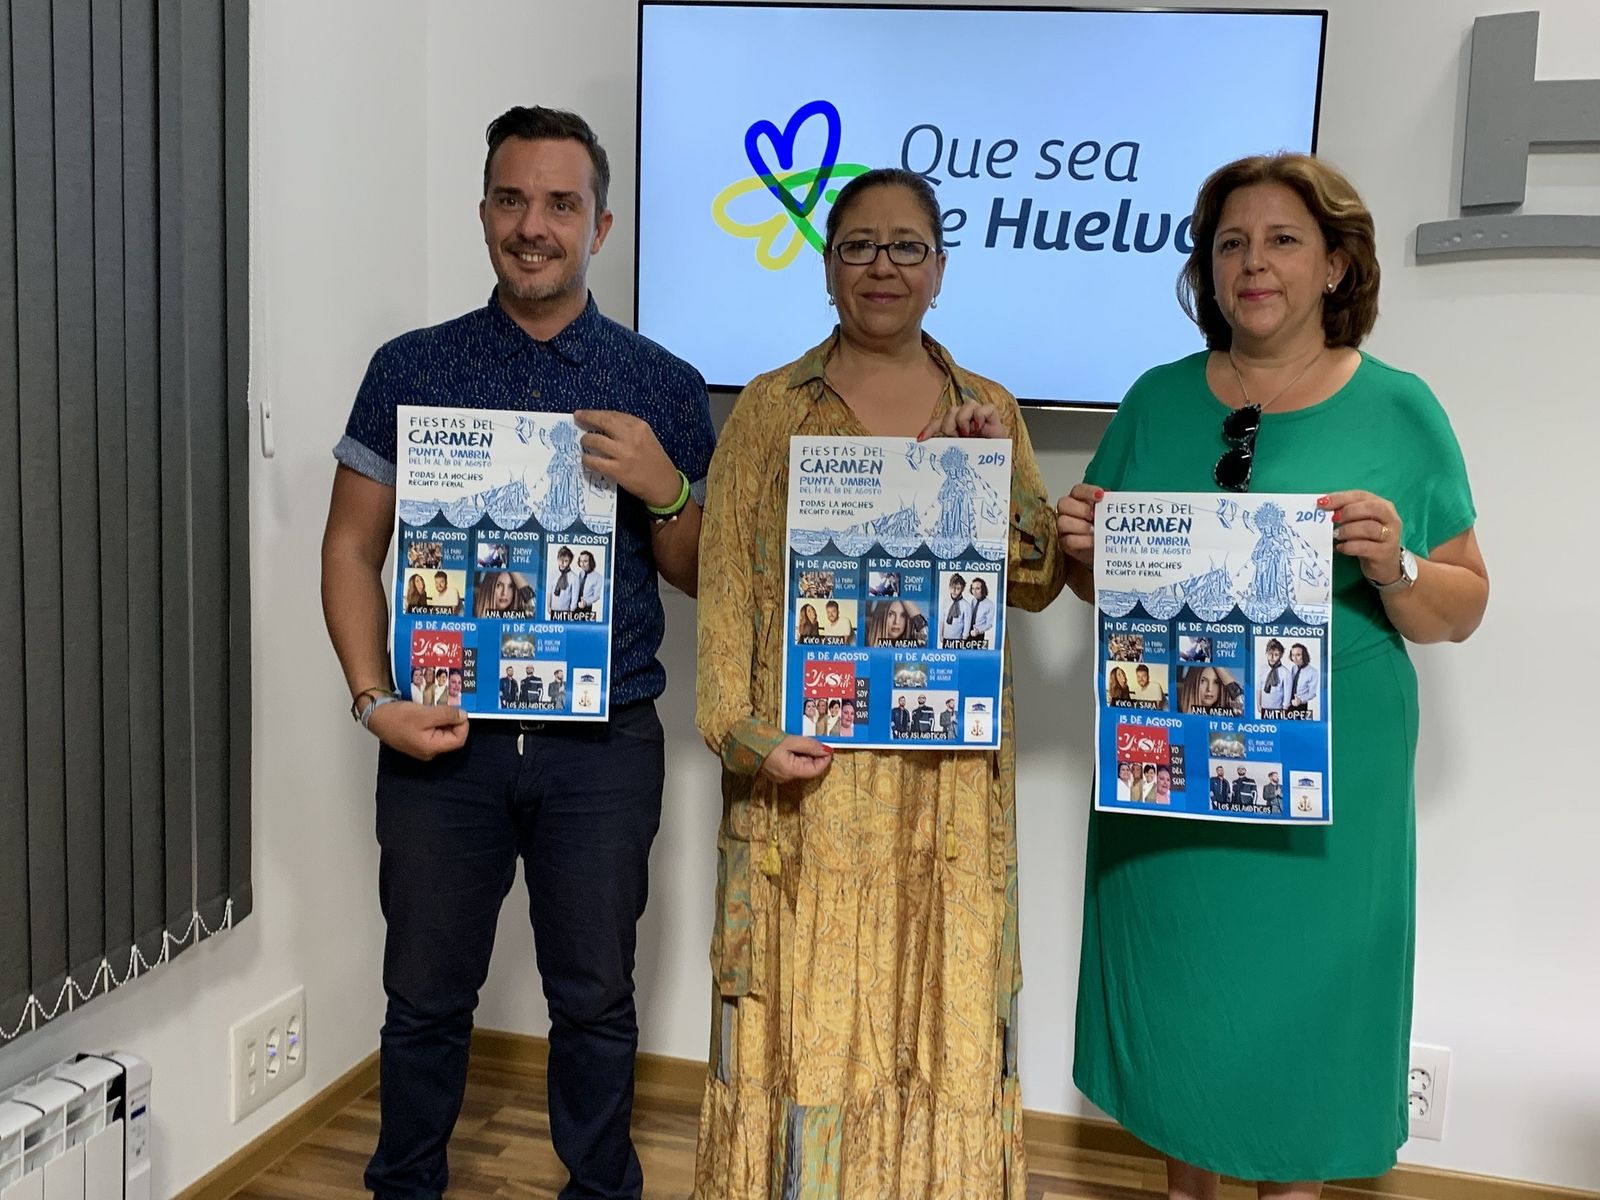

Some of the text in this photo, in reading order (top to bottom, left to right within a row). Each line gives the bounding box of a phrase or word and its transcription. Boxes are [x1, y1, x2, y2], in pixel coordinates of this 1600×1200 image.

[901, 124, 1140, 186] Que sea
[941, 208, 968, 248] e
[410, 417, 495, 430] FIESTAS DEL
[408, 430, 493, 448] CARMEN
[408, 447, 491, 460] PUNTA UMBRIA
[802, 446, 885, 457] FIESTAS DEL
[978, 454, 1005, 466] 2019
[800, 458, 883, 475] CARMEN
[451, 473, 483, 481] NOCHES
[800, 476, 881, 487] PUNTA UMBRIA
[408, 479, 464, 488] RECINTO FERIAL
[1107, 503, 1194, 514] FIESTAS DEL
[1296, 510, 1326, 524] 2019
[1105, 517, 1192, 533] CARMEN
[405, 530, 467, 541] 14 DE AGOSTO
[477, 531, 539, 541] 16 DE AGOSTO
[546, 534, 608, 545] 18 DE AGOSTO
[1105, 535, 1190, 547] PUNTA UMBRIA
[1106, 546, 1118, 554] DEL
[796, 560, 858, 570] 14 DE AGOSTO
[869, 559, 930, 568] 16 DE AGOSTO
[938, 562, 1001, 571] 18 DE AGOSTO
[1106, 560, 1132, 568] TODAS
[1148, 562, 1182, 570] NOCHES
[485, 610, 500, 618] ANA
[415, 621, 476, 631] 15 DE AGOSTO
[502, 624, 564, 633] 17 DE AGOSTO
[1105, 621, 1167, 633] 14 DE AGOSTO
[1178, 623, 1245, 634] 16 DE AGOSTO
[1253, 626, 1324, 636] 18 DE AGOSTO
[878, 639, 892, 647] ANA
[807, 652, 869, 661] 15 DE AGOSTO
[895, 653, 956, 662] 17 DE AGOSTO
[1216, 650, 1235, 658] STYLE
[1191, 706, 1208, 715] ANA
[1263, 709, 1312, 720] ANTILOPEZ
[1120, 715, 1182, 727] 15 DE AGOSTO
[1210, 721, 1277, 733] 17 DE AGOSTO
